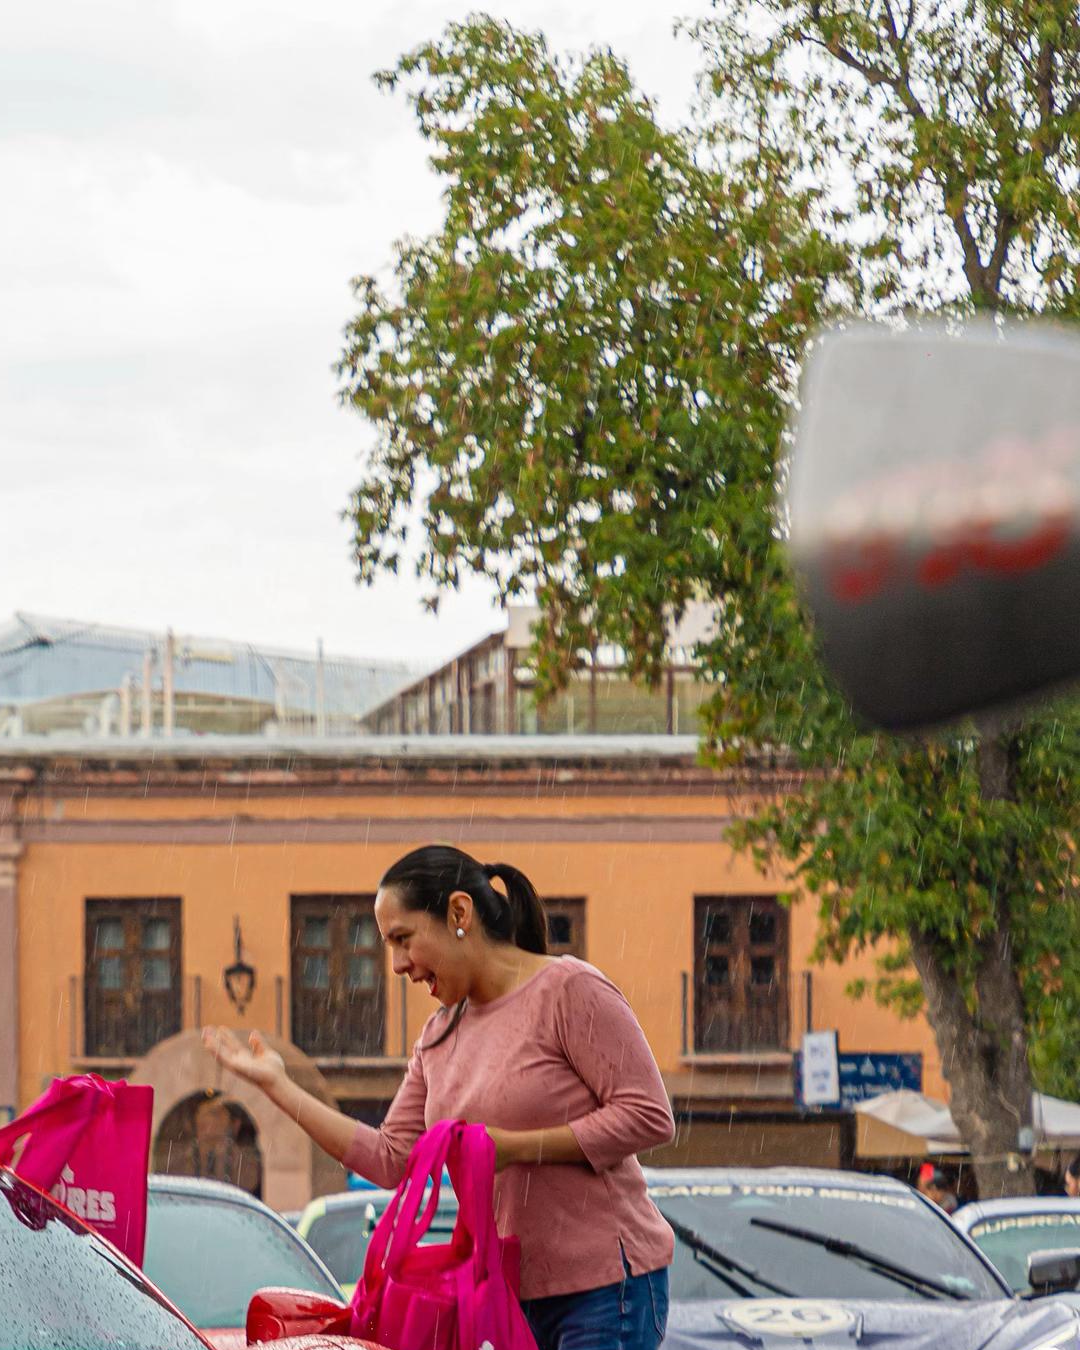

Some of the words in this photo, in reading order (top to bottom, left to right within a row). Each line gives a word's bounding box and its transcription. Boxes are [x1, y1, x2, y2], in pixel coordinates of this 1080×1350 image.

[739, 1185, 814, 1197] TOUR
[820, 1189, 917, 1208] MEXICO
[971, 1214, 1080, 1238] SUPERCA
